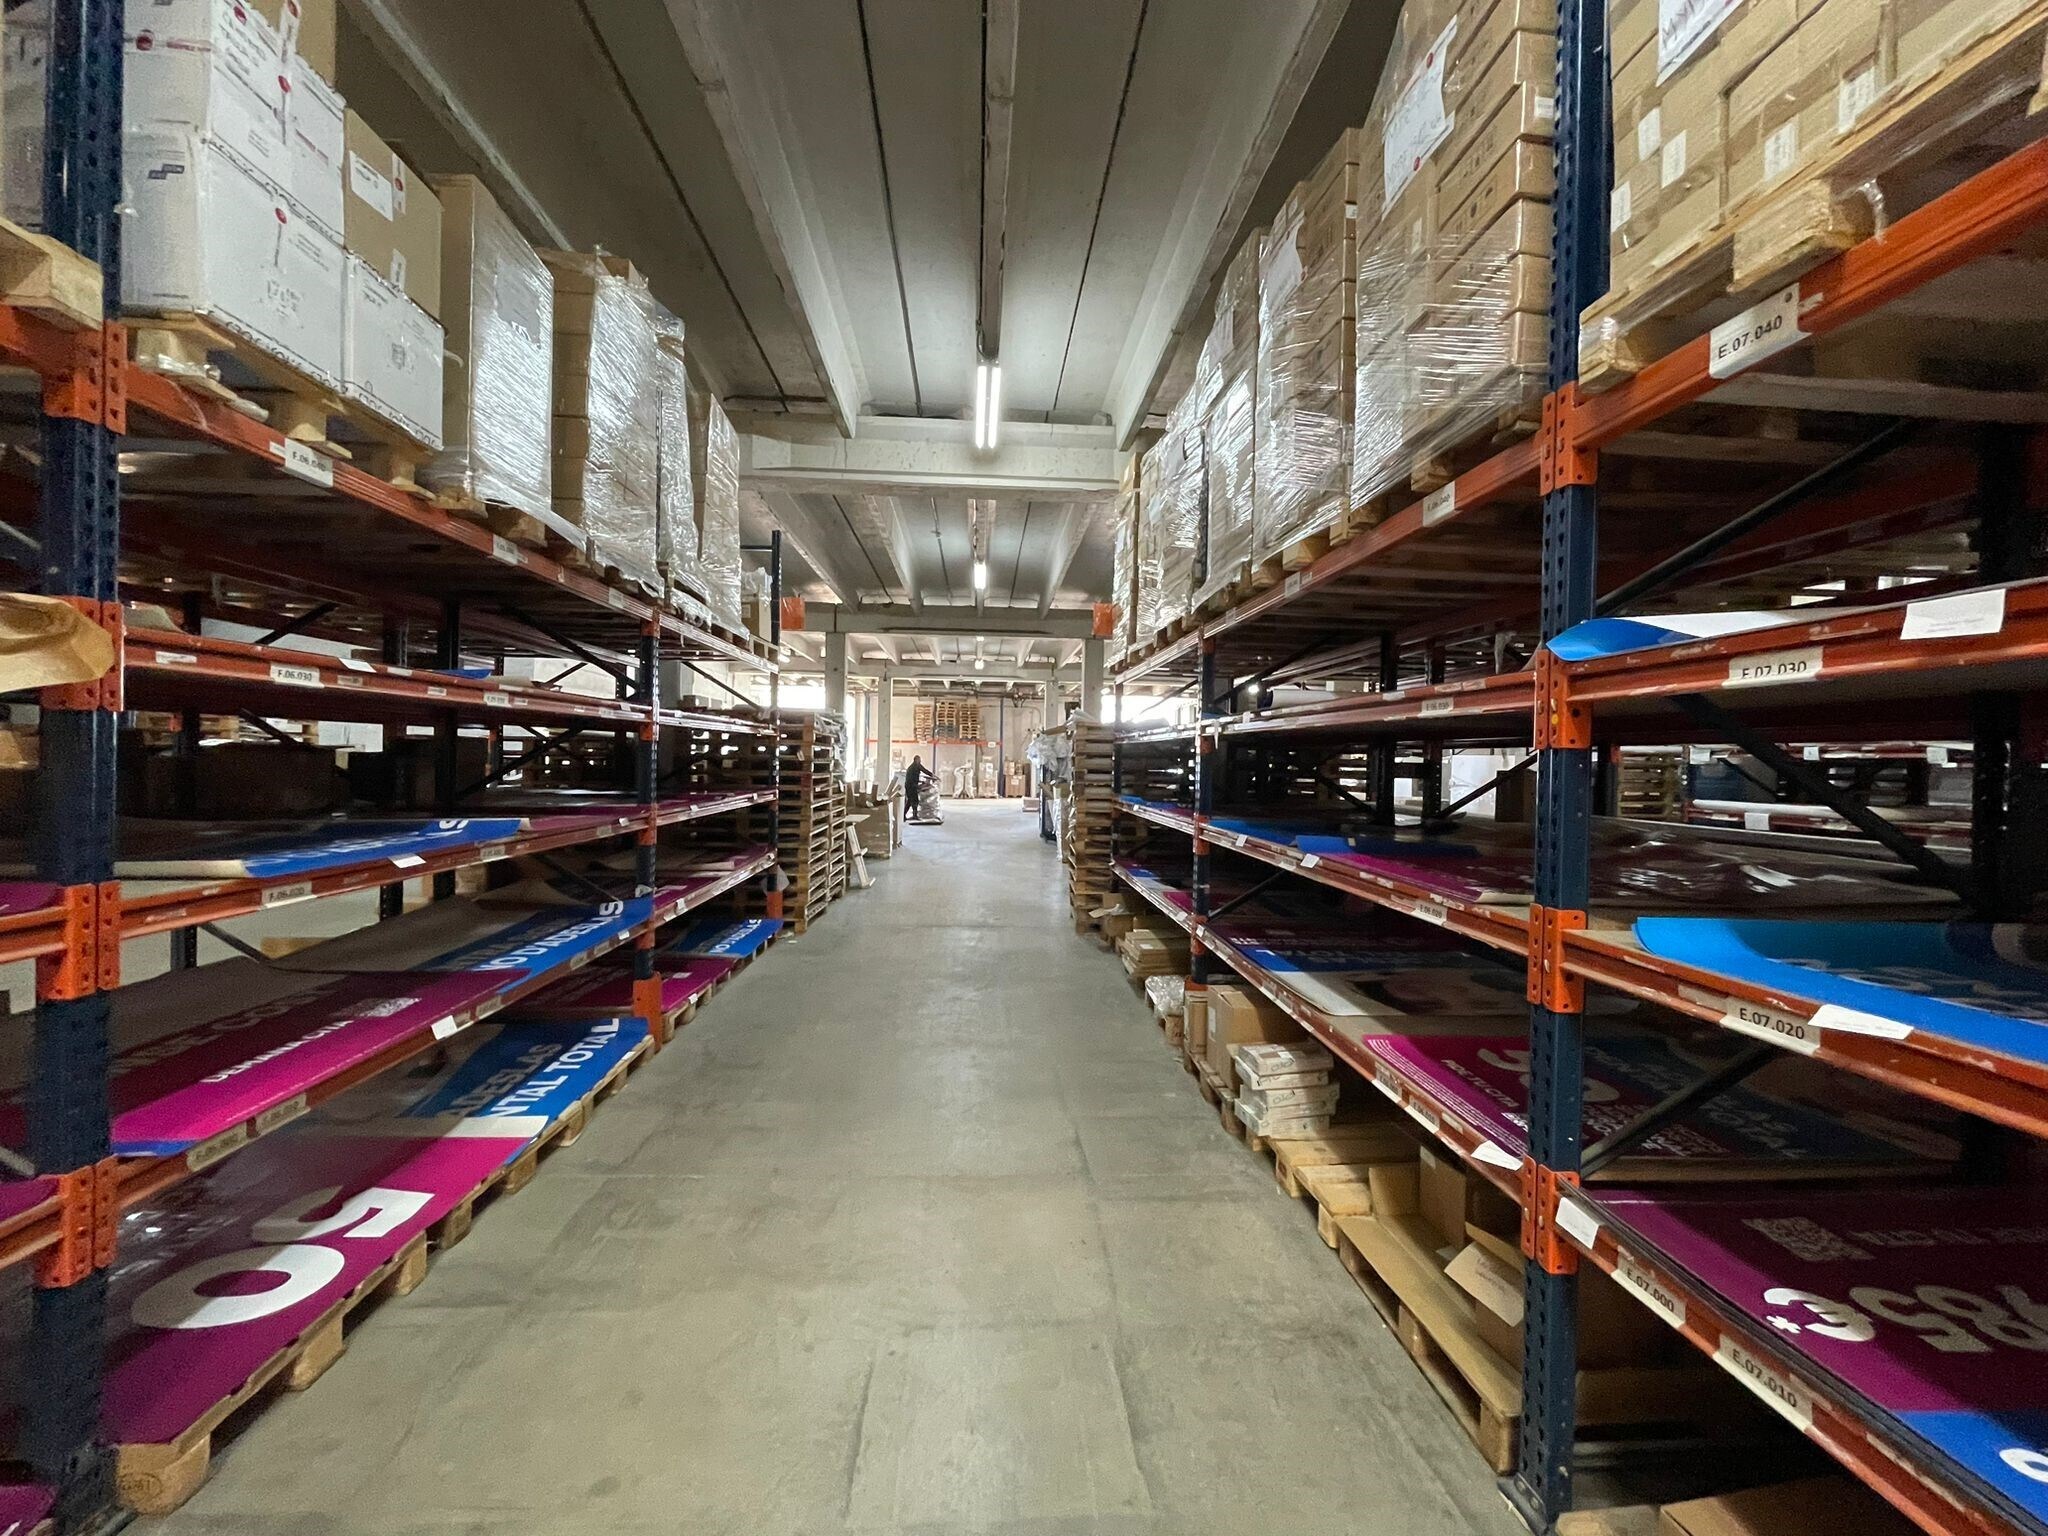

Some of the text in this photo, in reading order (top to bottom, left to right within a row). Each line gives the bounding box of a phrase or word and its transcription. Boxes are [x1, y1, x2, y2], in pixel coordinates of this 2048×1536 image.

[1718, 315, 1783, 359] E.07.040
[277, 669, 312, 682] F.06.030
[543, 1018, 620, 1073] TOTAL
[1740, 1008, 1805, 1040] E.07.020
[1627, 1268, 1675, 1314] E.07.000
[1733, 1348, 1798, 1408] E.07.010
